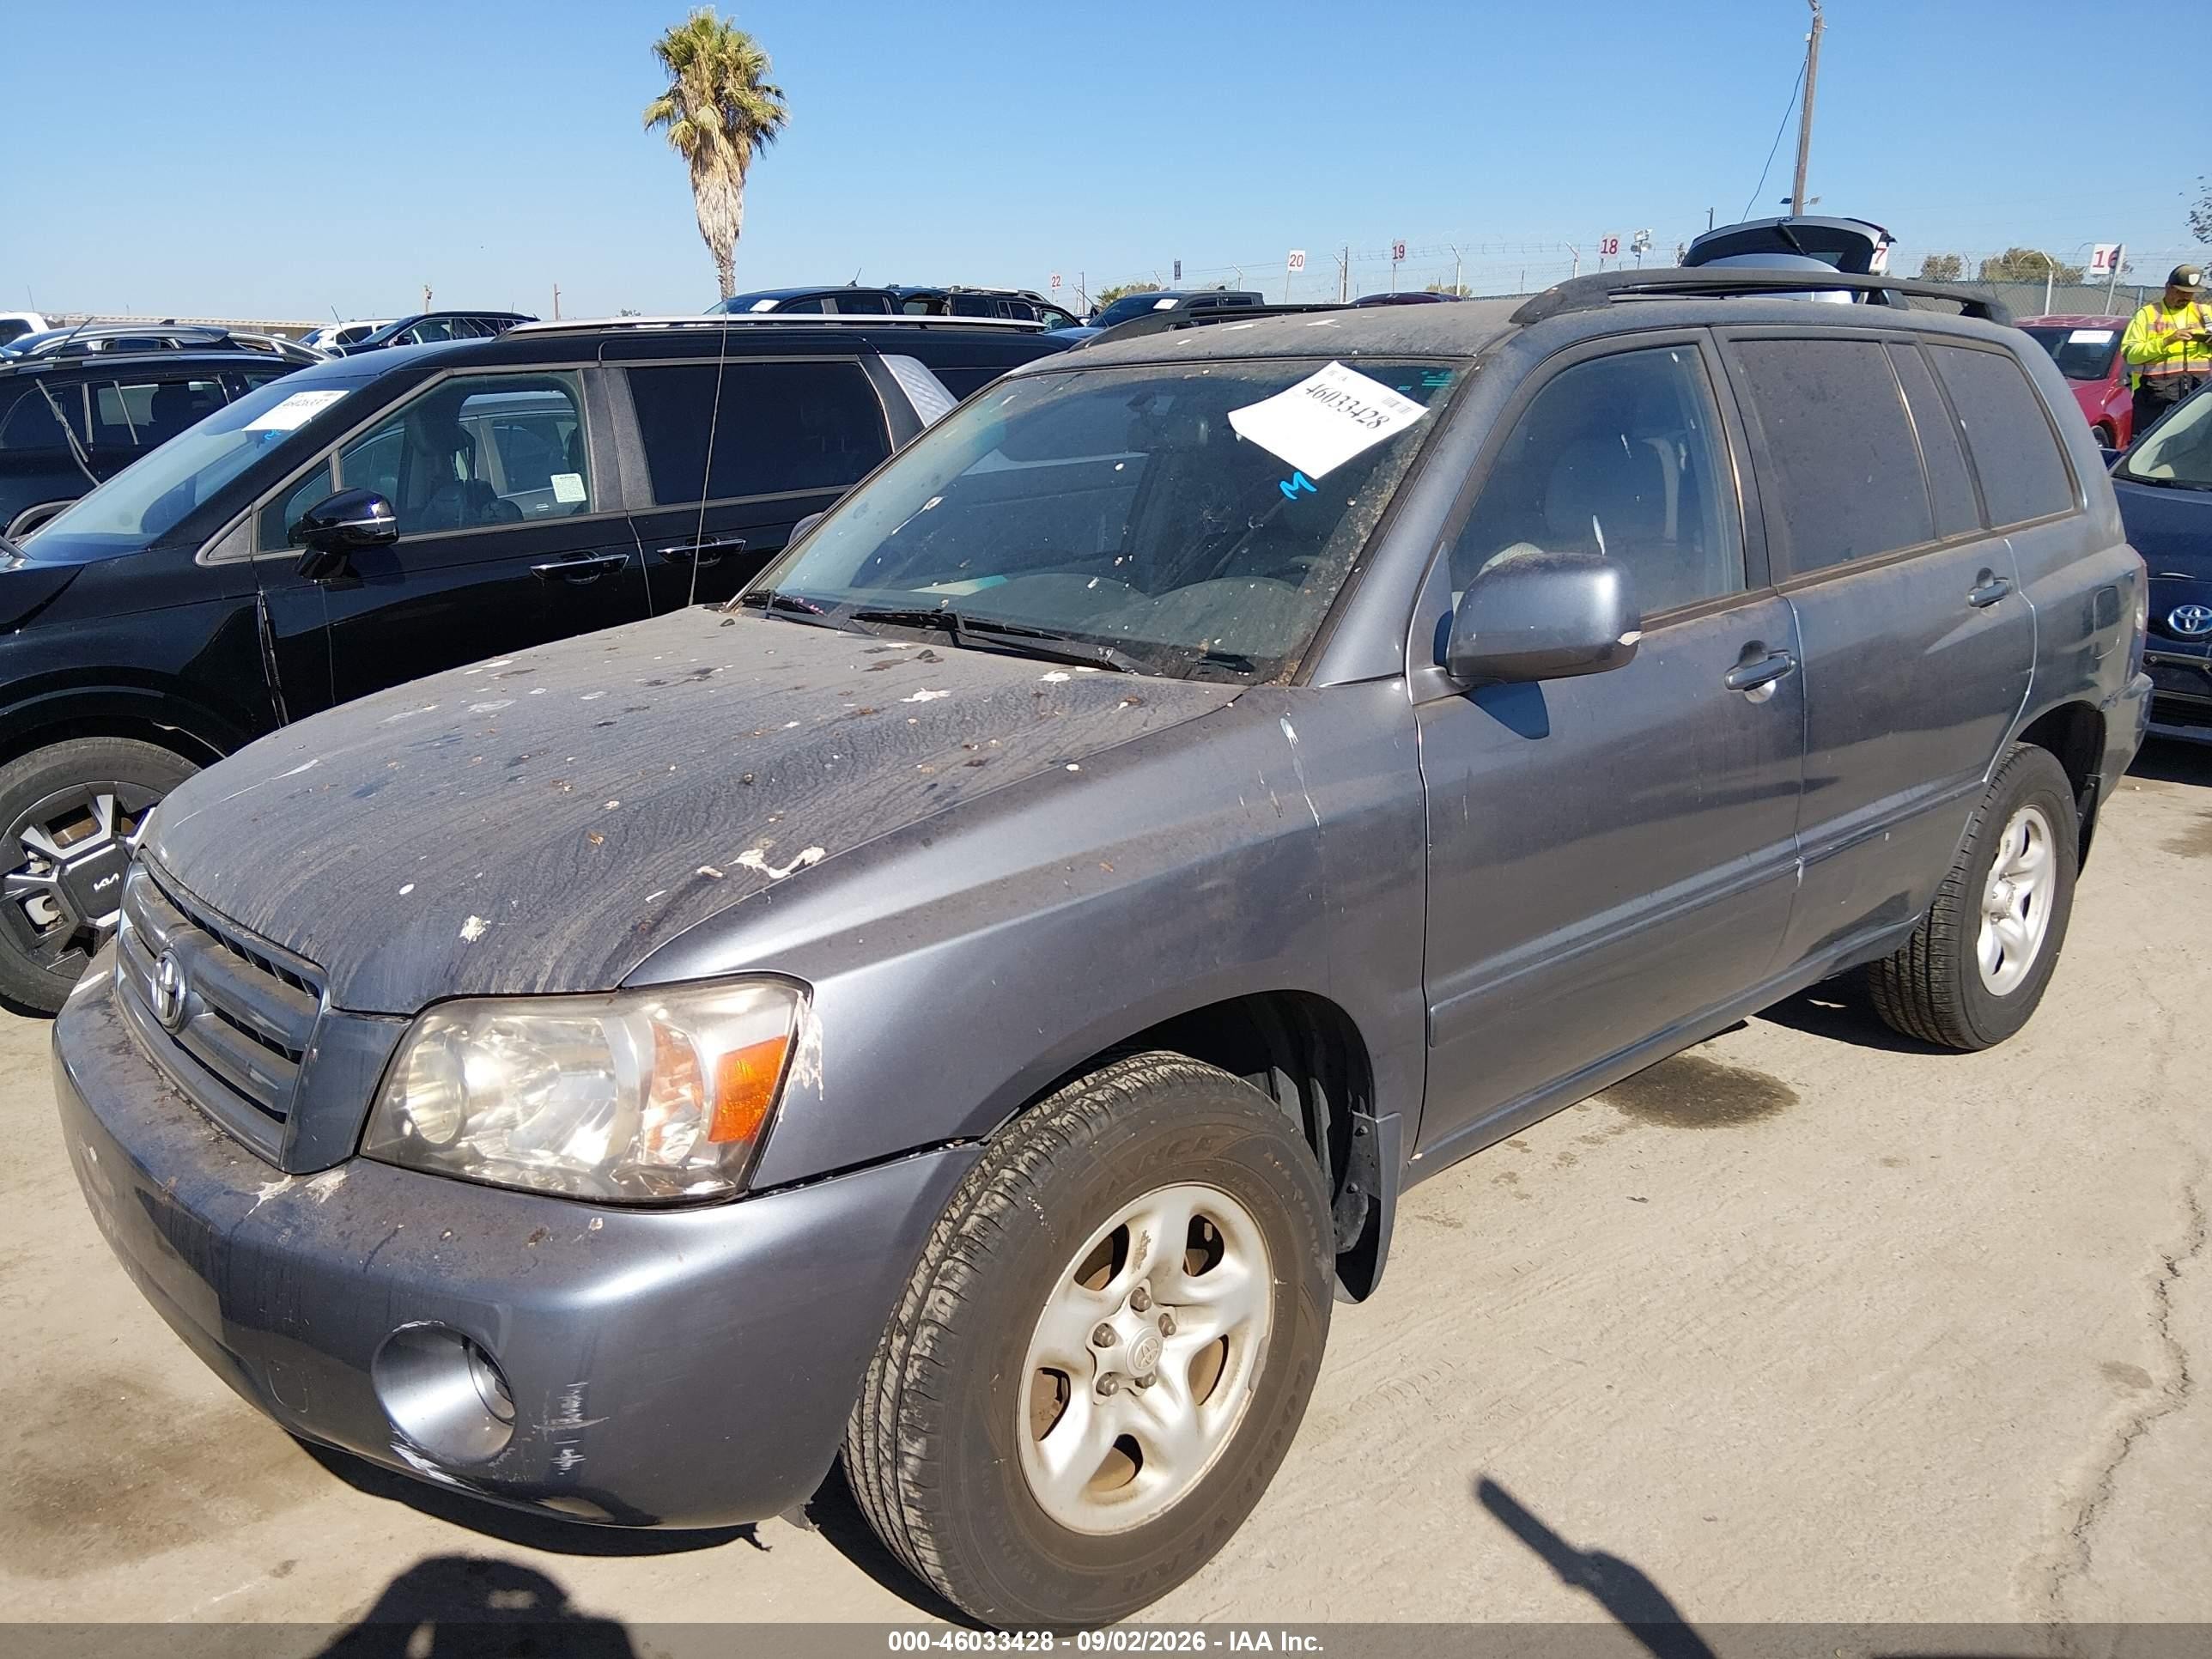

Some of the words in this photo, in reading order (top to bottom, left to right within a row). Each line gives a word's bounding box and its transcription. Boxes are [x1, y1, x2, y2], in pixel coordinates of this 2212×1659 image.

[1392, 245, 1405, 259] 19
[1601, 239, 1618, 254] 18
[1289, 254, 1304, 267] 20
[2093, 250, 2119, 269] 16
[1051, 276, 1061, 288] 22
[1305, 383, 1390, 429] 46033428
[1279, 471, 1318, 501] M
